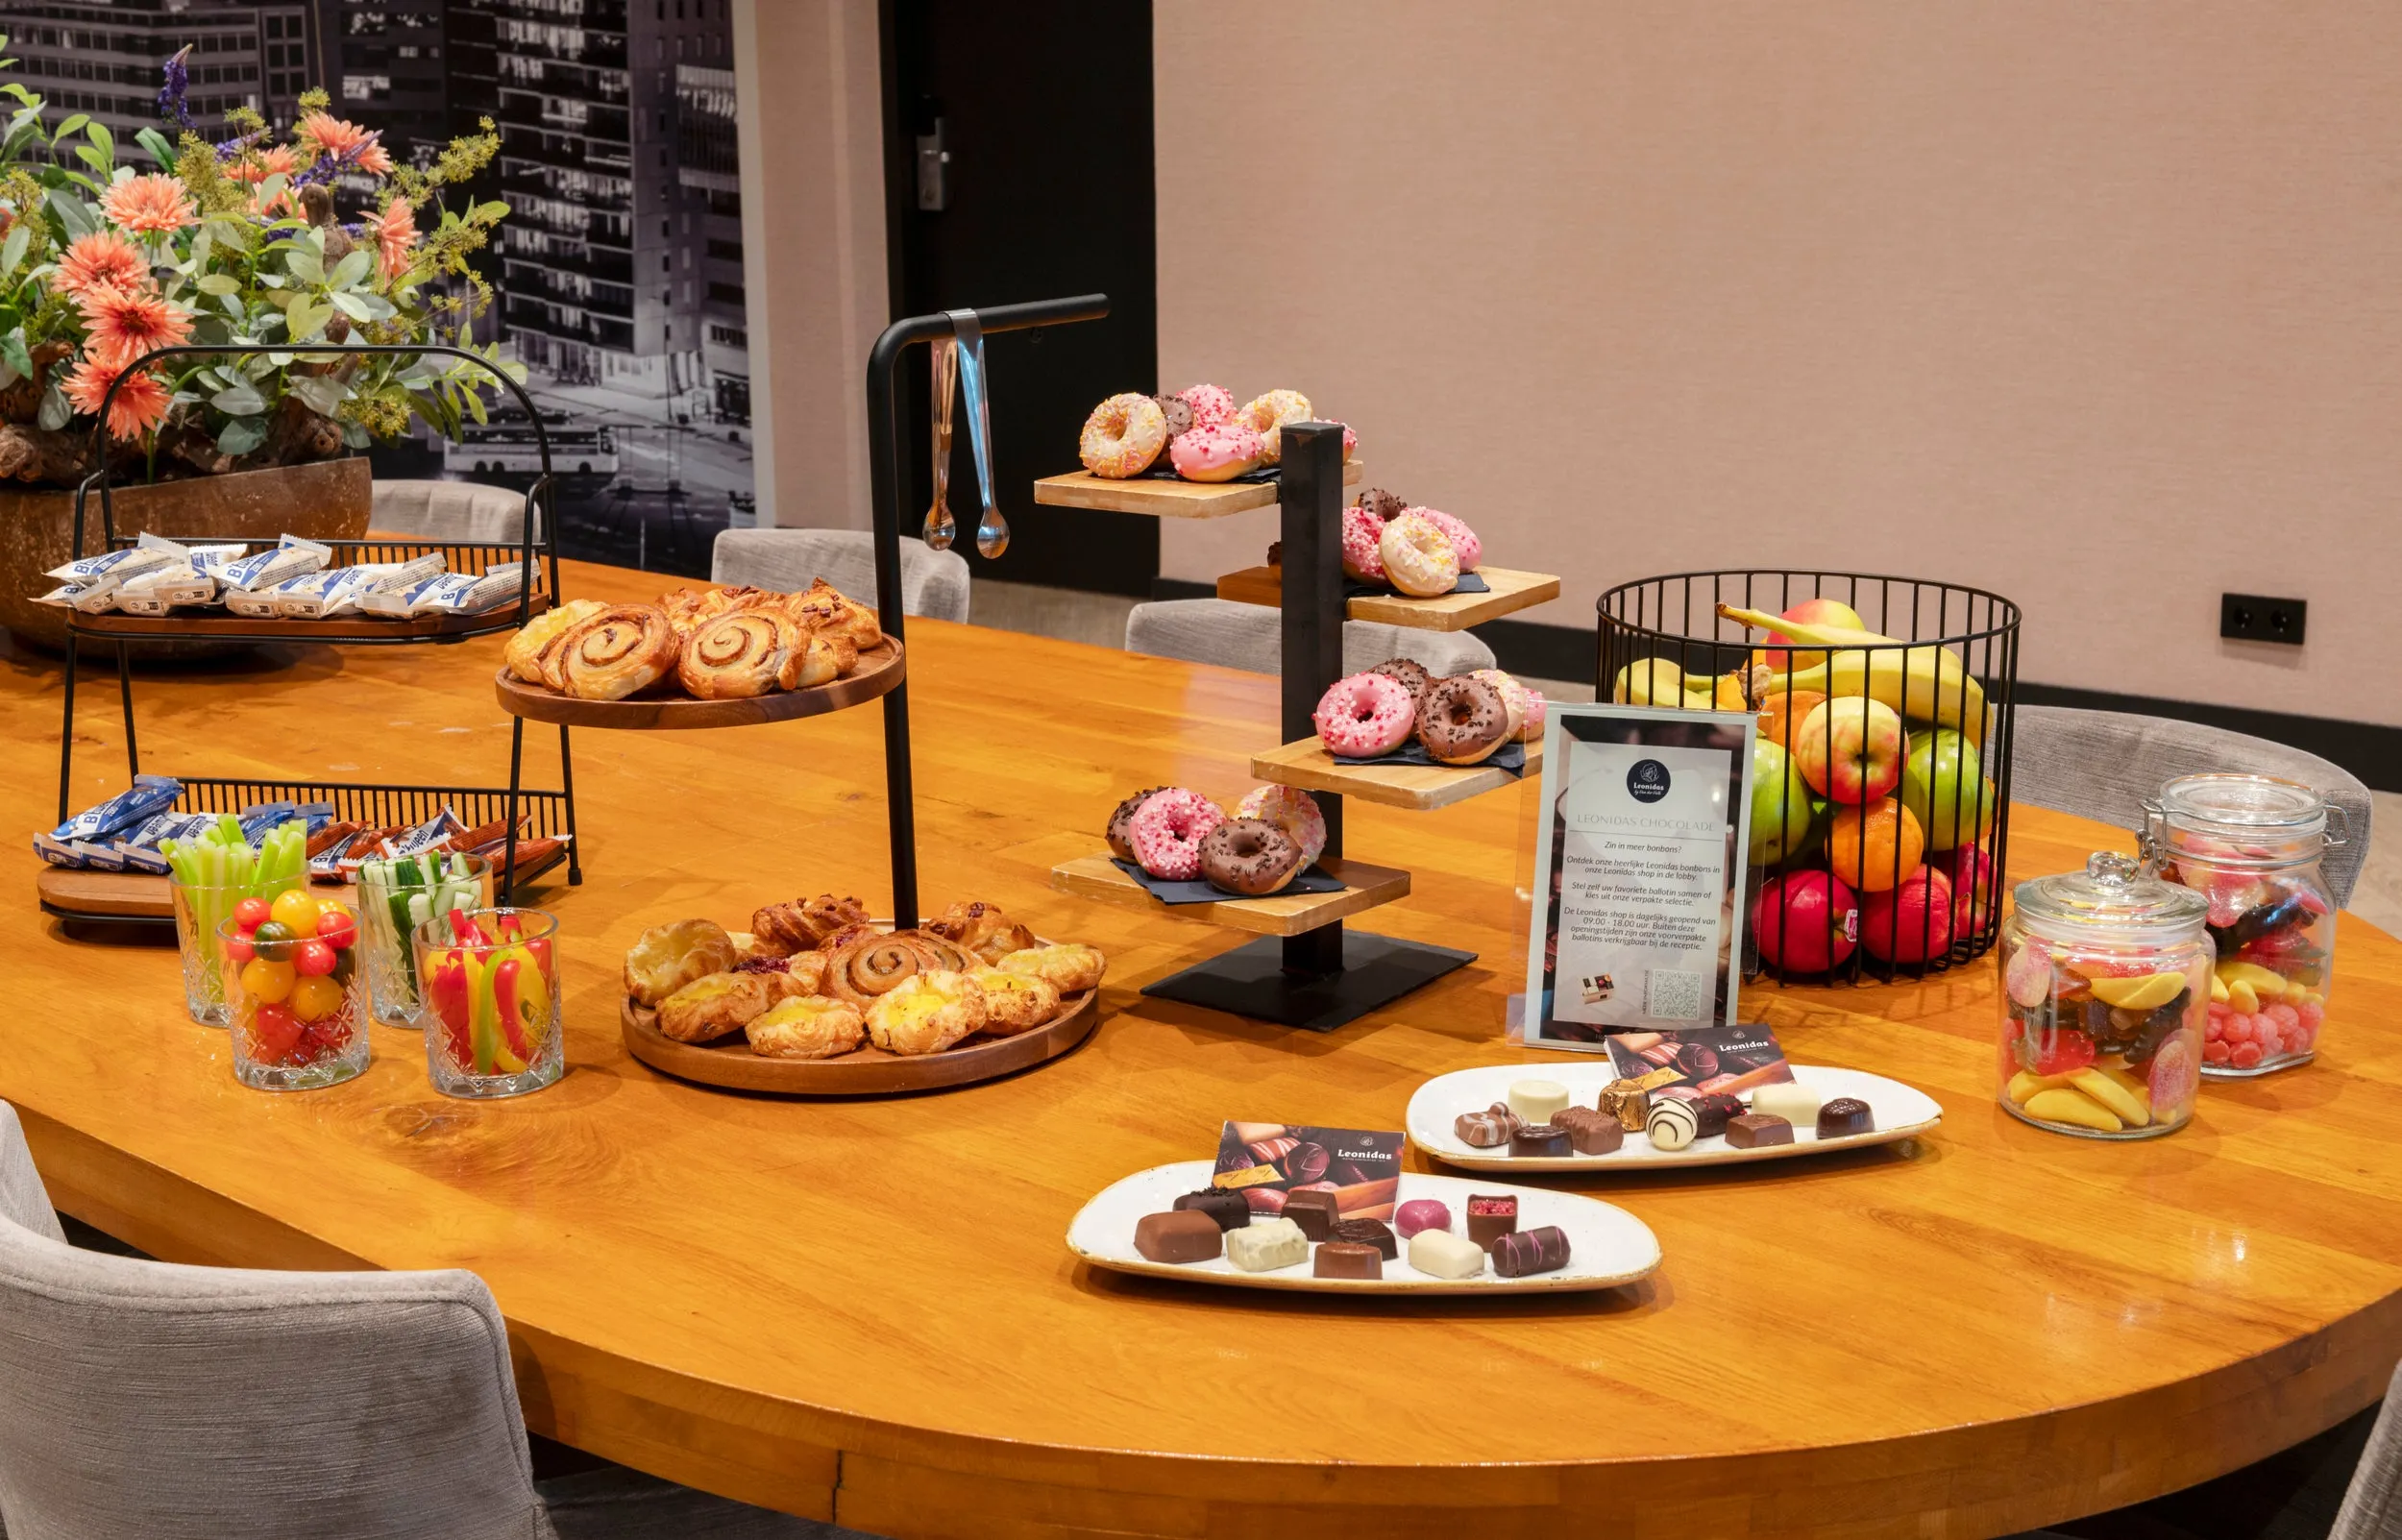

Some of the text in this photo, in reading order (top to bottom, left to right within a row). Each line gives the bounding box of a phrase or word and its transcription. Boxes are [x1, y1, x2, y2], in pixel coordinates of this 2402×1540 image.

[1634, 782, 1664, 791] Leonidas
[1578, 815, 1714, 832] LEONIDAS CHOCOLADE
[1605, 841, 1616, 849] Zin
[1647, 844, 1681, 853] bonbons?
[1567, 855, 1593, 865] Ontdek
[1614, 859, 1644, 869] heerlijke
[1647, 862, 1678, 870] Leonidas
[1680, 864, 1710, 872] bonbons
[1605, 868, 1635, 876] Leonidas
[1638, 869, 1654, 878] shop
[1665, 870, 1674, 879] de
[1677, 870, 1698, 881] lobby.
[1585, 891, 1599, 899] kies
[1631, 894, 1662, 904] verpakte
[1665, 897, 1694, 907] selectie.
[1614, 884, 1647, 894] favoriete
[1649, 887, 1676, 896] ballotin
[1678, 890, 1702, 898] samen
[1703, 891, 1711, 899] of
[1577, 907, 1607, 917] Leonidas
[1609, 910, 1627, 918] shop
[1636, 912, 1667, 922] dagelijks
[1669, 915, 1701, 924] geopend
[1583, 917, 1605, 925] 09.00
[1612, 918, 1634, 927] 18.00
[1653, 922, 1676, 931] Buiten
[1679, 923, 1695, 932] deze
[1571, 925, 1623, 936] openingstijden
[1625, 929, 1637, 938] zijn
[1658, 931, 1706, 942] voorverpakte
[1572, 934, 1702, 951] ballotins verkrijgbaar bij de receptie.
[1719, 1040, 1769, 1052] Leonidas
[1337, 1149, 1392, 1161] Leonidas
